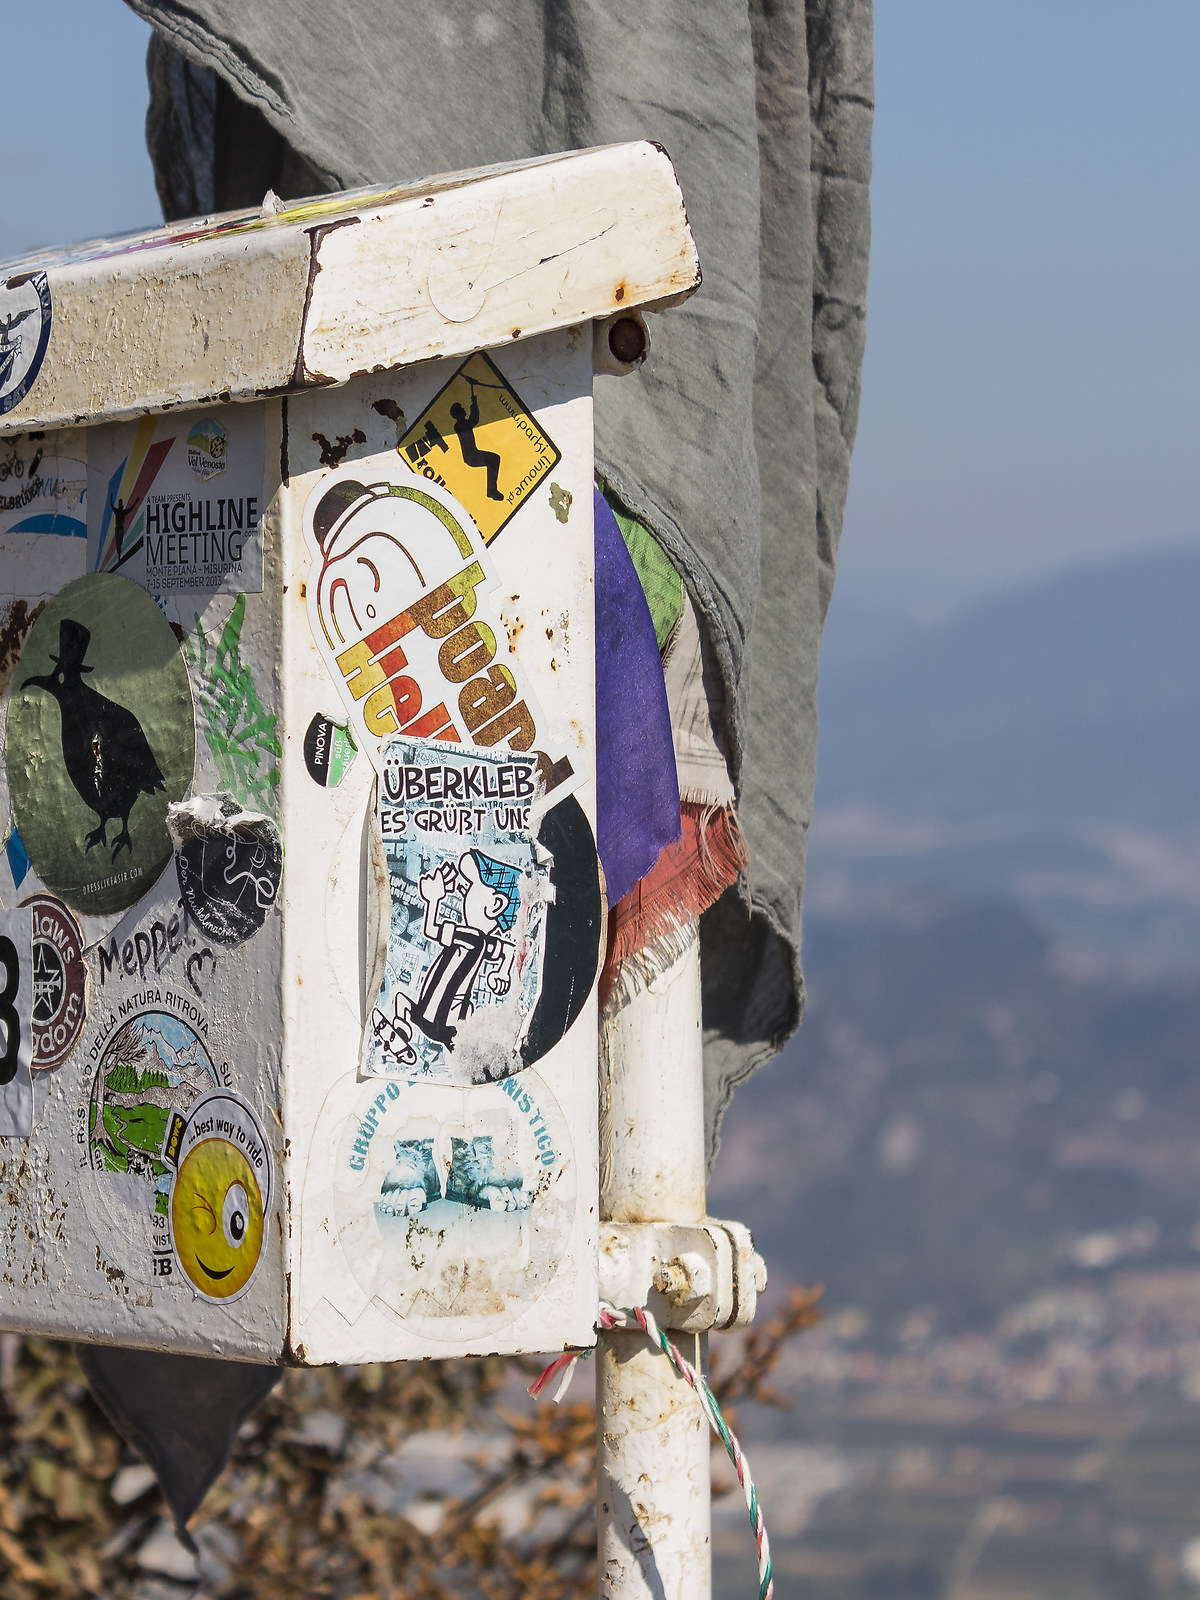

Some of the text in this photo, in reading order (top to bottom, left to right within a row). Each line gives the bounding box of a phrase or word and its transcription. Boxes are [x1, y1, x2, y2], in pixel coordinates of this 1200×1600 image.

[31, 271, 52, 325] ARDA
[146, 497, 258, 535] HIGHLINE
[166, 493, 191, 502] PRESENTS
[146, 530, 242, 566] MEETING
[146, 563, 243, 577] MONTE PIANA MISURINA
[146, 575, 222, 589] 7-15 SEPTEMBER 2013
[314, 723, 328, 765] PINOVA
[384, 759, 536, 800] ÜBERKLEB
[381, 810, 407, 834] ES
[82, 867, 144, 895] DRESSLIKEASIR.COM
[32, 911, 75, 964] laws
[88, 1014, 118, 1061] DELLA
[117, 990, 162, 1018] NATURA
[215, 1118, 236, 1140] way
[235, 1125, 247, 1143] to
[245, 1139, 263, 1169] ride
[348, 1082, 401, 1172] GRUPPO
